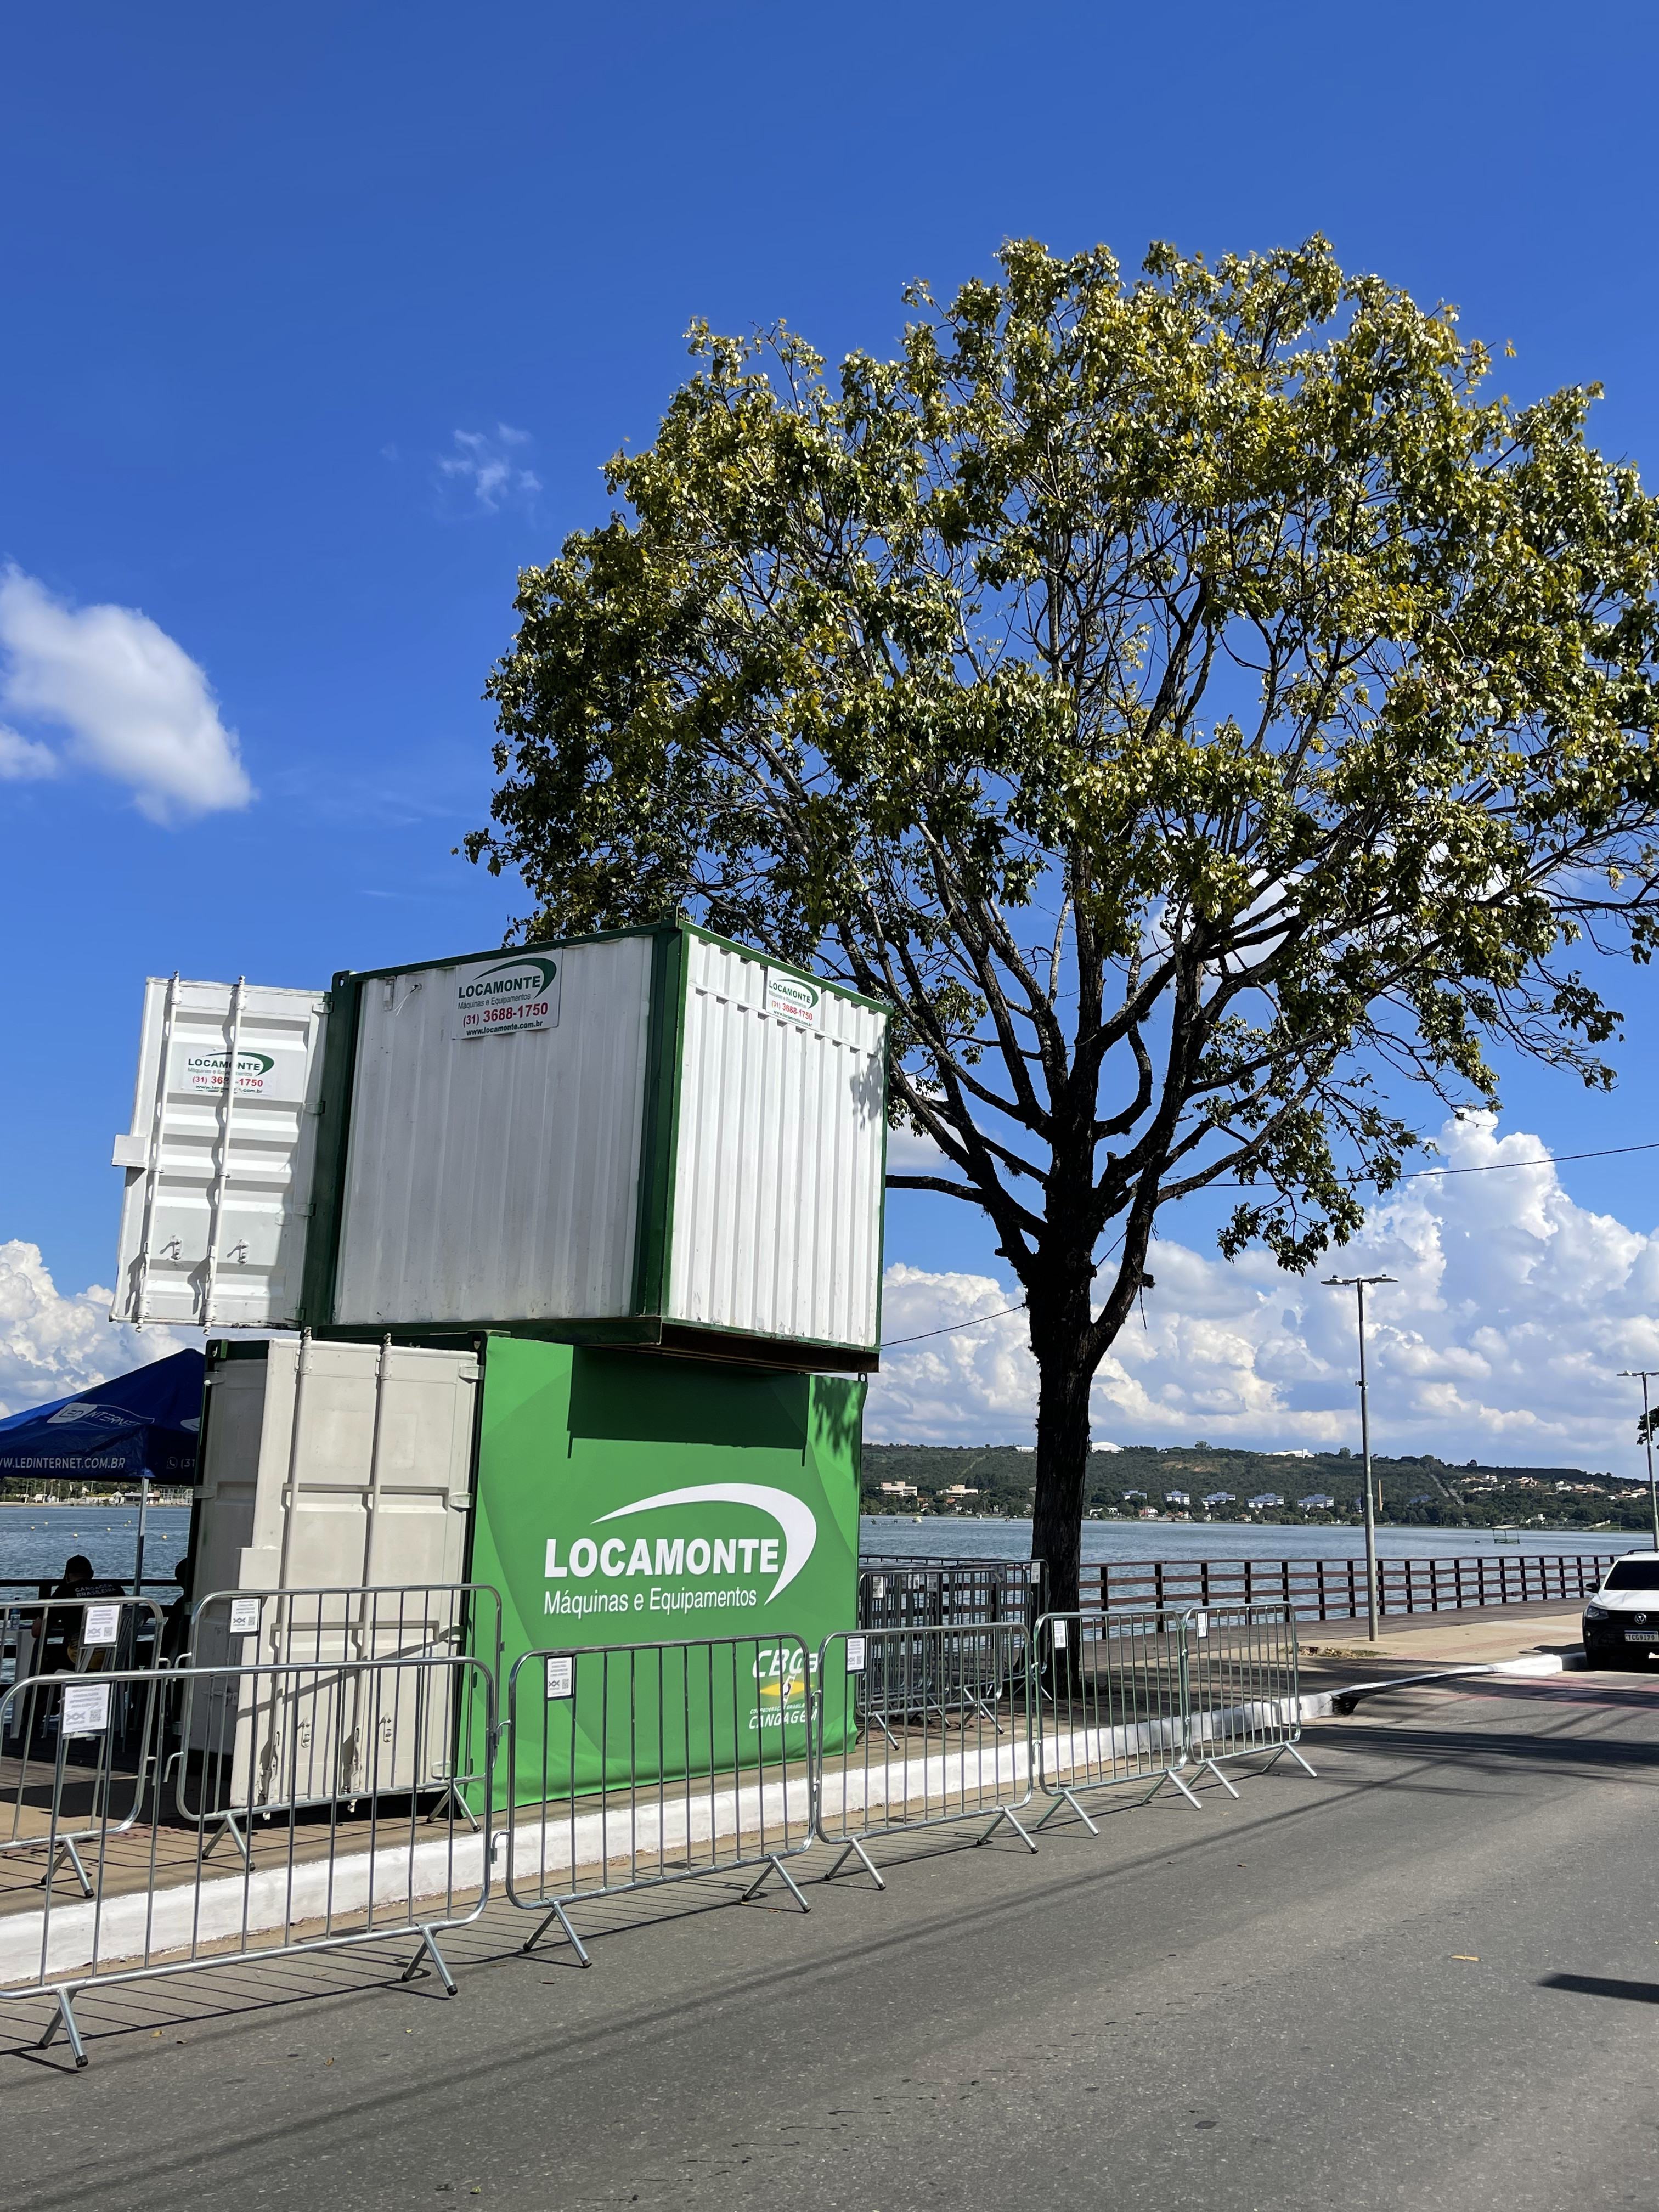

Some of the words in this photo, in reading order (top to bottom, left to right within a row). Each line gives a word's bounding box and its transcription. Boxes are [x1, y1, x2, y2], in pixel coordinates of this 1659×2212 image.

[459, 975, 540, 998] LOCAMONTE
[769, 980, 811, 1003] LOCAMONTE
[458, 1000, 484, 1010] Máquinas
[491, 994, 531, 1006] Equipamentos
[771, 1000, 781, 1010] (31)
[782, 1003, 812, 1020] 3688-1750
[463, 1014, 479, 1028] (31)
[483, 1002, 548, 1023] 3688-1750
[466, 1020, 543, 1035] www.locamonte.com.br
[188, 1058, 261, 1070] LOCAMNTE
[211, 1076, 263, 1087] 368-1750
[544, 1537, 780, 1578] LOCAMONTE
[544, 1590, 628, 1619] Máquinas
[634, 1593, 644, 1611] e
[650, 1587, 757, 1615] Equipamentos
